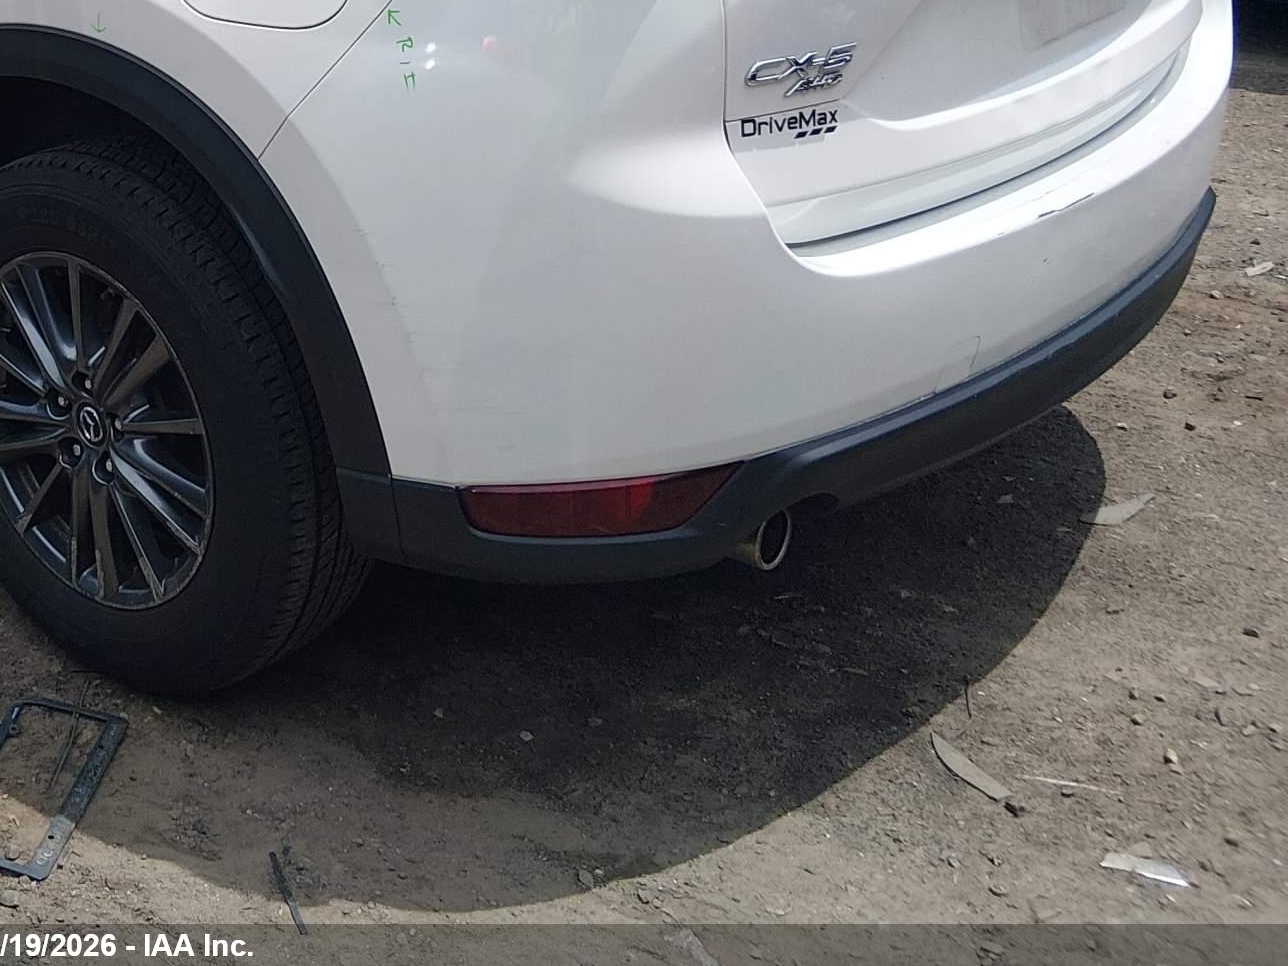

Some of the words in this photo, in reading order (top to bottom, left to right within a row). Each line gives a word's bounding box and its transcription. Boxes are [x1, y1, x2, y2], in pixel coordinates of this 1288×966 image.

[745, 42, 857, 86] CX-5
[784, 73, 843, 97] AWD
[740, 109, 838, 138] DriveMax
